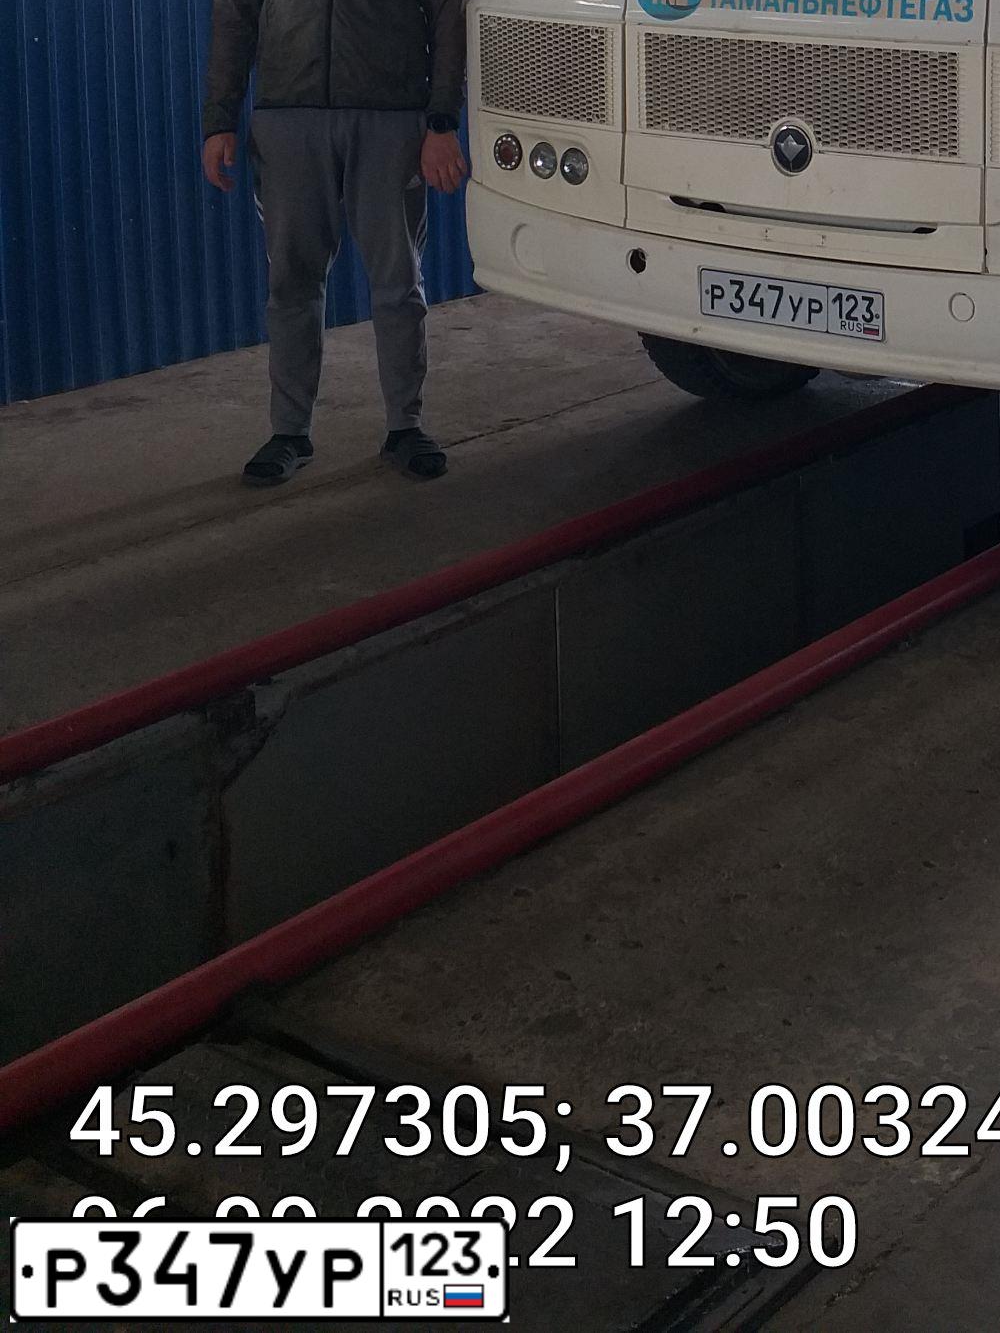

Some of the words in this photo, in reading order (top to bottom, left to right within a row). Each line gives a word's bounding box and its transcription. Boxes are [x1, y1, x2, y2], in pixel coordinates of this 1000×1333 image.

[710, 279, 824, 324] Р347УР
[831, 292, 875, 323] 123
[840, 320, 863, 333] RUS
